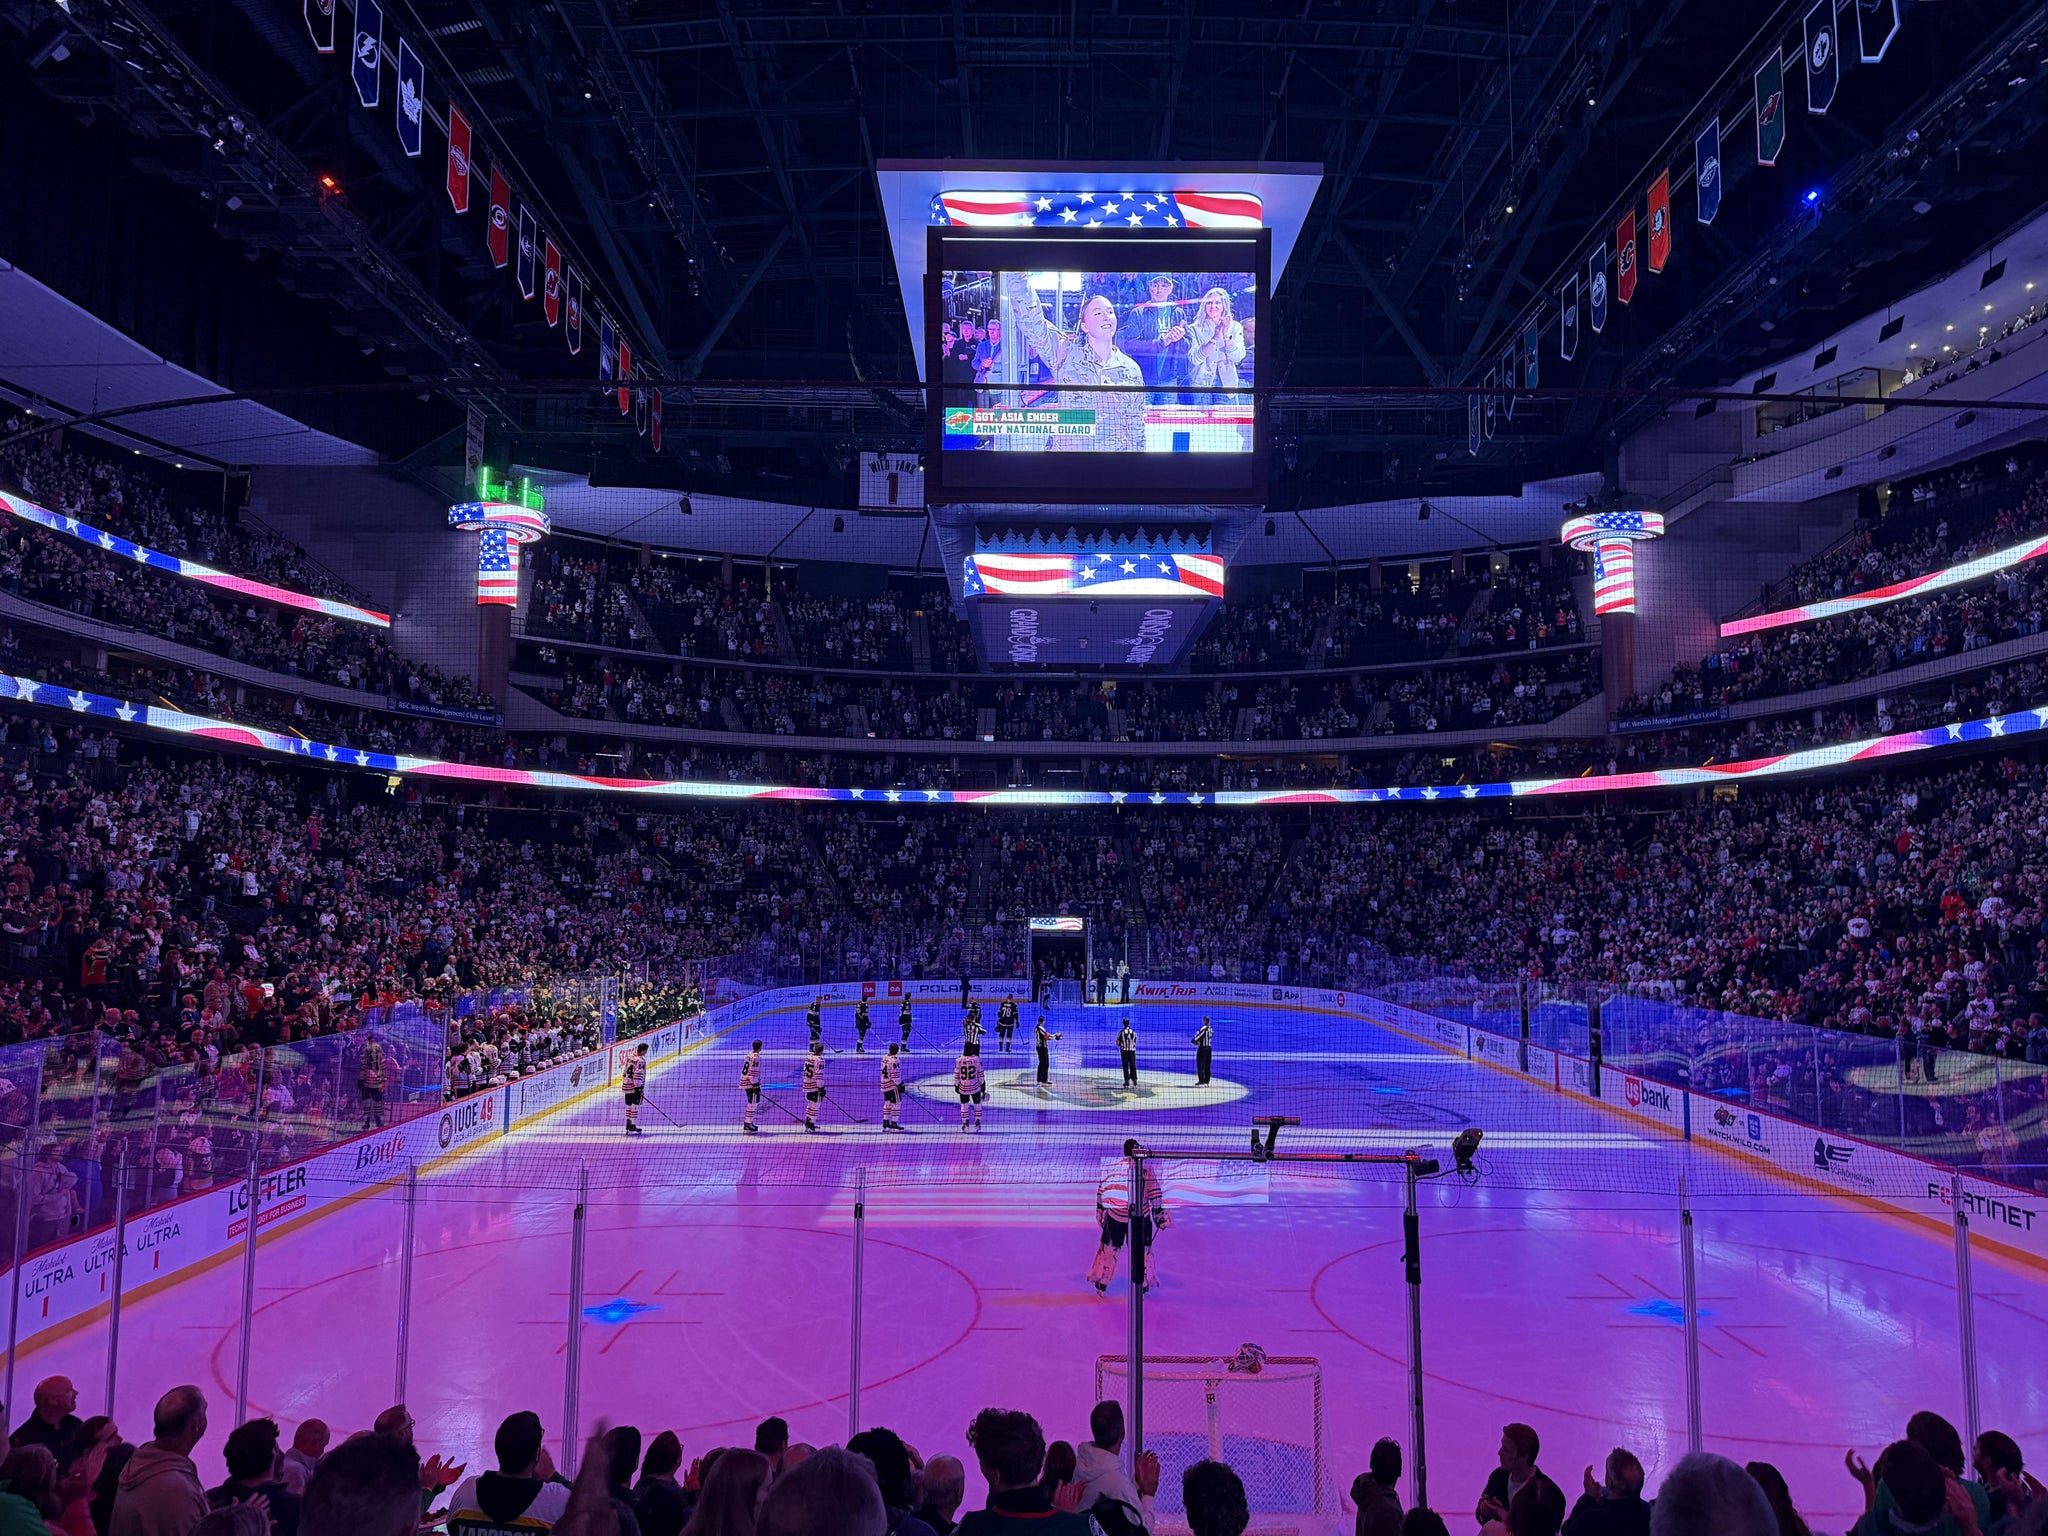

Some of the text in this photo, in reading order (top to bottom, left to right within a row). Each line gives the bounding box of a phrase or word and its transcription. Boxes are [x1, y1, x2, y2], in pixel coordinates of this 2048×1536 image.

[975, 412, 1059, 422] SGT. ASIA ENGER
[975, 425, 1091, 434] ARMY NATIONAL GUARD
[868, 459, 917, 475] WILD FANS
[886, 472, 899, 504] 1
[430, 706, 466, 718] Management
[466, 711, 479, 719] Club
[479, 712, 495, 721] Level
[1702, 710, 1718, 718] Level
[919, 984, 983, 993] POLAIS
[1089, 982, 1118, 993] bnk
[1283, 991, 1300, 1000] App
[1001, 1003, 1012, 1018] 78
[660, 1031, 677, 1048] TRIA
[960, 1065, 976, 1080] 92
[1641, 1081, 1671, 1111] bank
[454, 1102, 478, 1134] IUOE
[480, 1096, 494, 1122] 49
[1707, 1127, 1771, 1155] WATCH.WILD.COM
[355, 1130, 406, 1170] Bonfe
[136, 1223, 181, 1252] ULTRA
[25, 1265, 74, 1299] ULTRA
